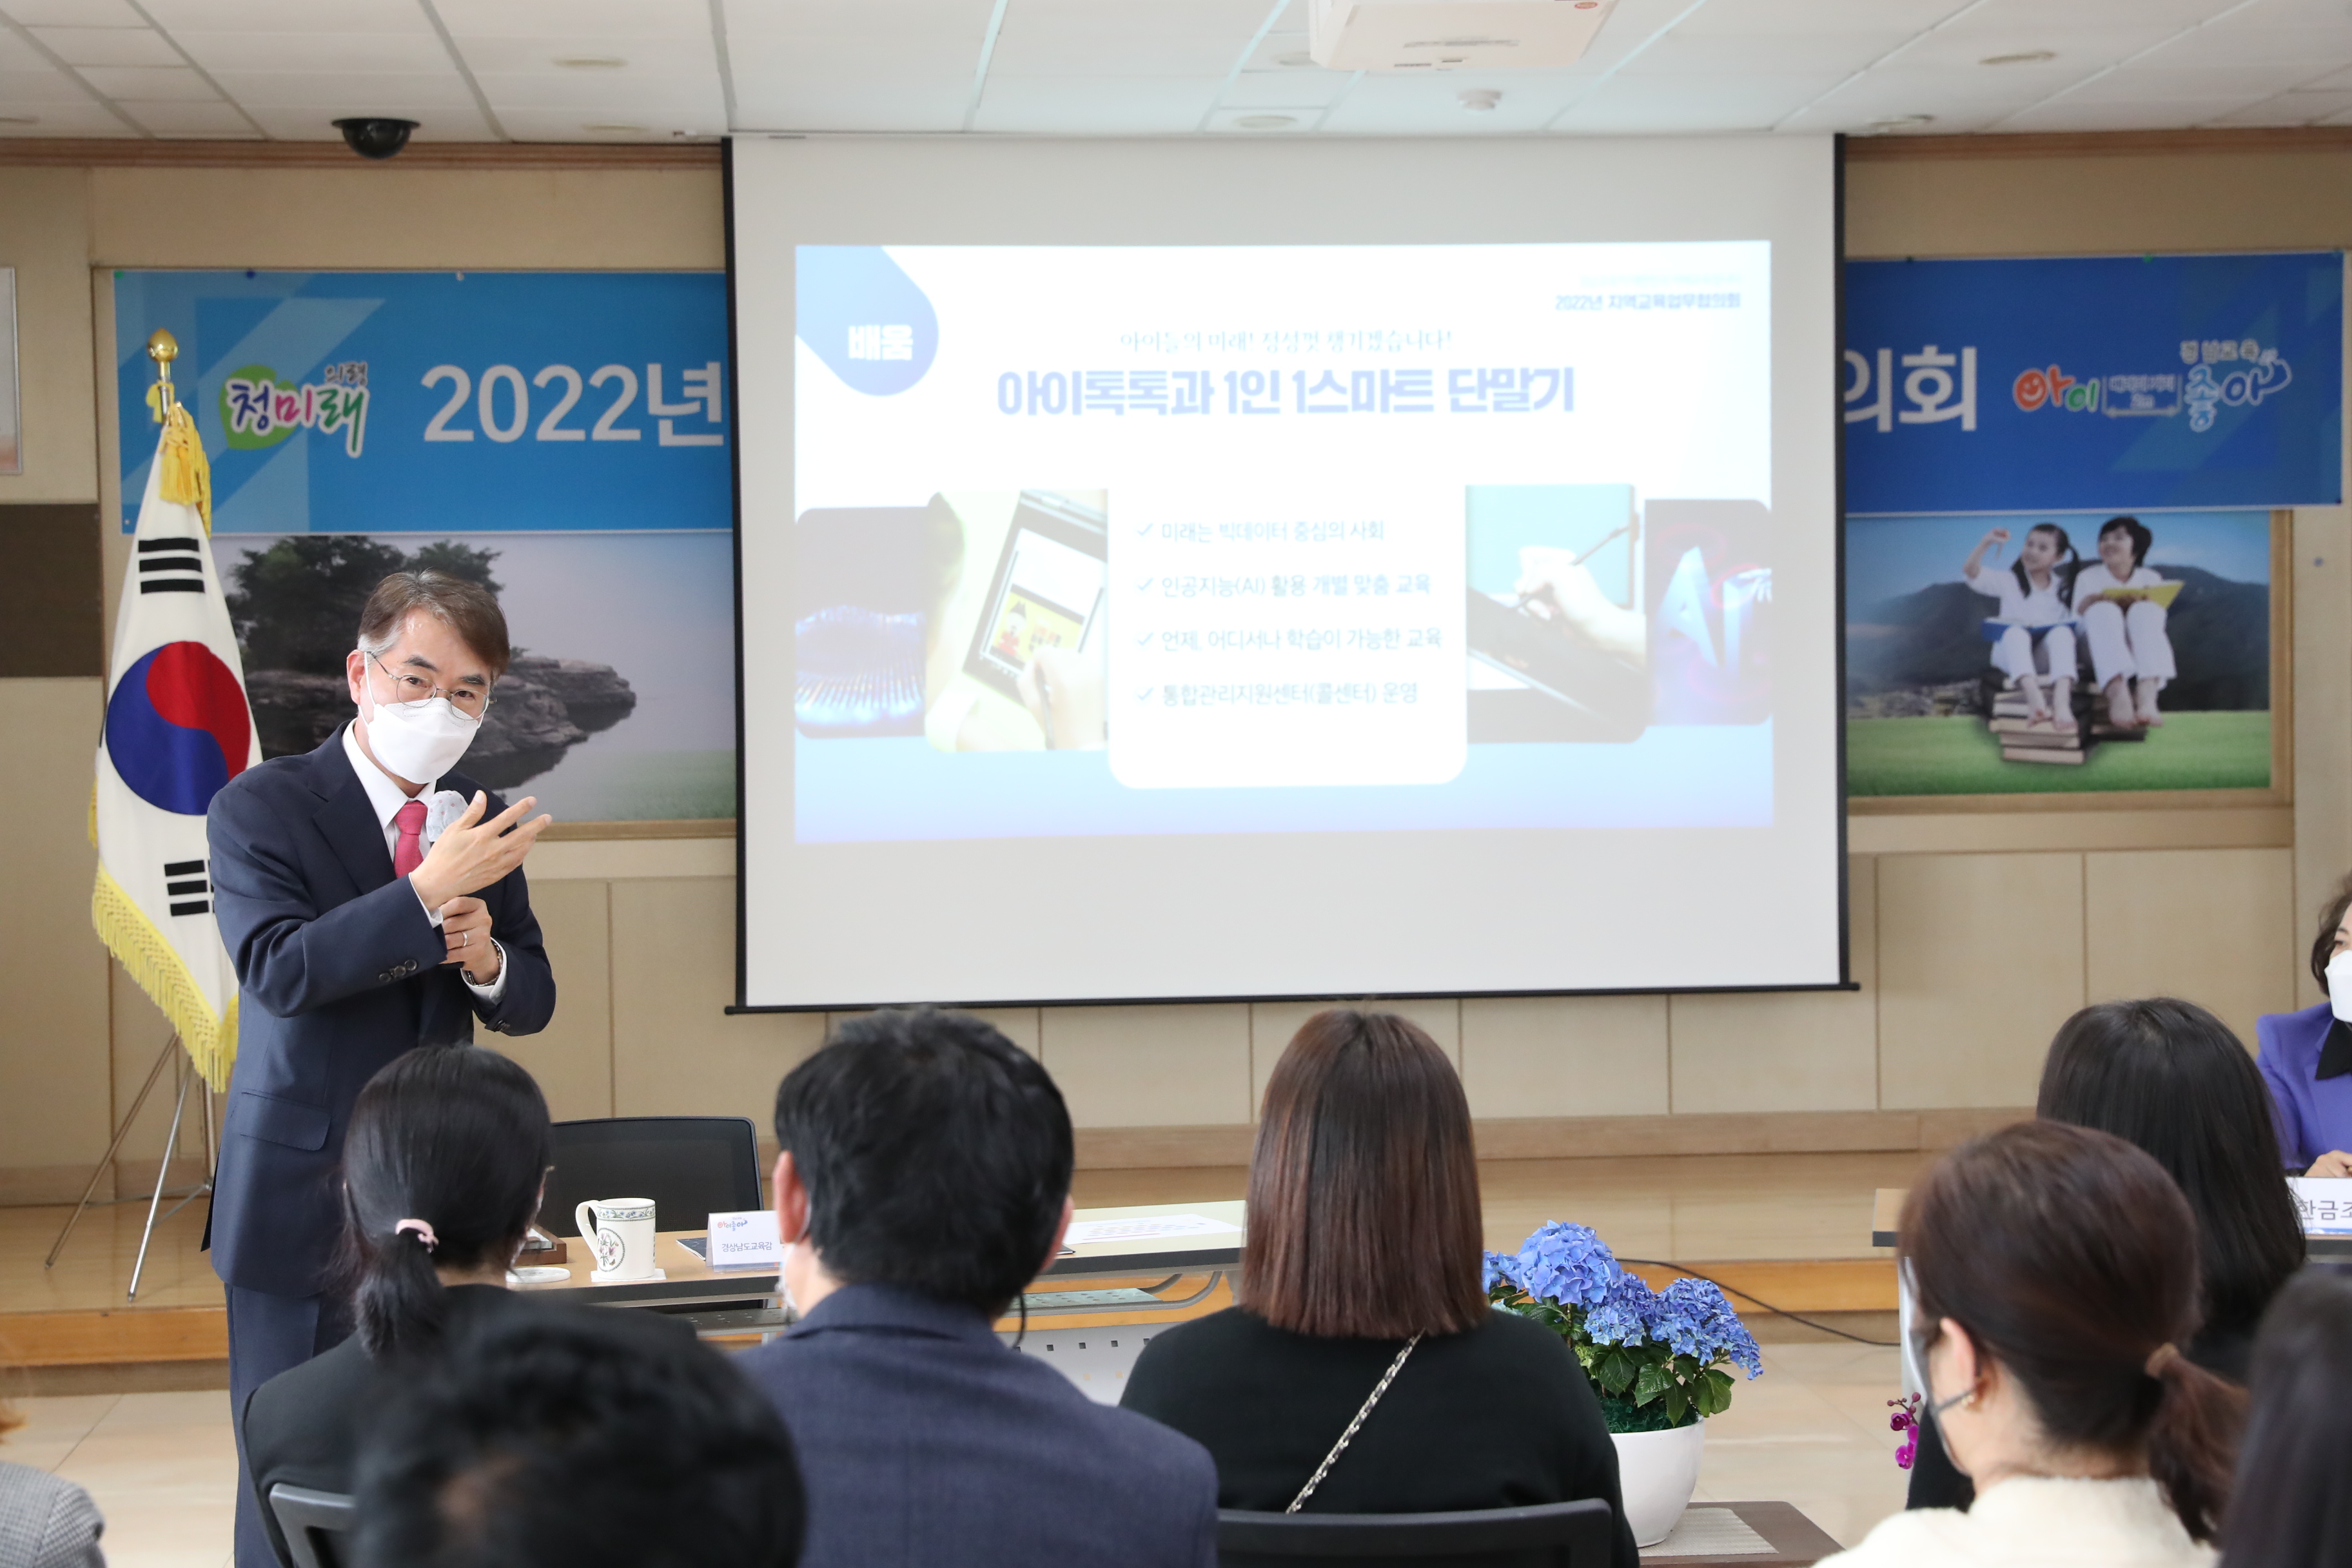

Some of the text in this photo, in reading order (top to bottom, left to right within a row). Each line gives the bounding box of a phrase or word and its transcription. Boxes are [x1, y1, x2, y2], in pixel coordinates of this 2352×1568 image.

[1555, 293, 1604, 311] 2022년
[848, 324, 913, 360] 배움
[1121, 331, 1200, 353] 아이들의
[1208, 330, 1254, 353] 미래!
[1262, 330, 1319, 354] 정성껏
[325, 361, 368, 386] 의령
[997, 367, 1575, 416] 아이톡톡과 1인 1스마트 단말기
[1844, 345, 1977, 433] 의회
[2012, 362, 2293, 433] 아이 좋아
[420, 361, 724, 446] 2022년
[227, 379, 370, 458] 청미래
[1162, 520, 1384, 544] 미래는 빅데이터 중심의 사회
[1162, 573, 1431, 598] 인공지능(AI) 활용 개별 맞춤 교육
[1162, 627, 1442, 652] 언제, 어디서나 학습이 가능한 교육
[1162, 681, 1418, 707] 통합관리지원센터(콜센터) 운영
[718, 1219, 748, 1231] 아이좋아
[721, 1242, 772, 1252] 경상남도교육감
